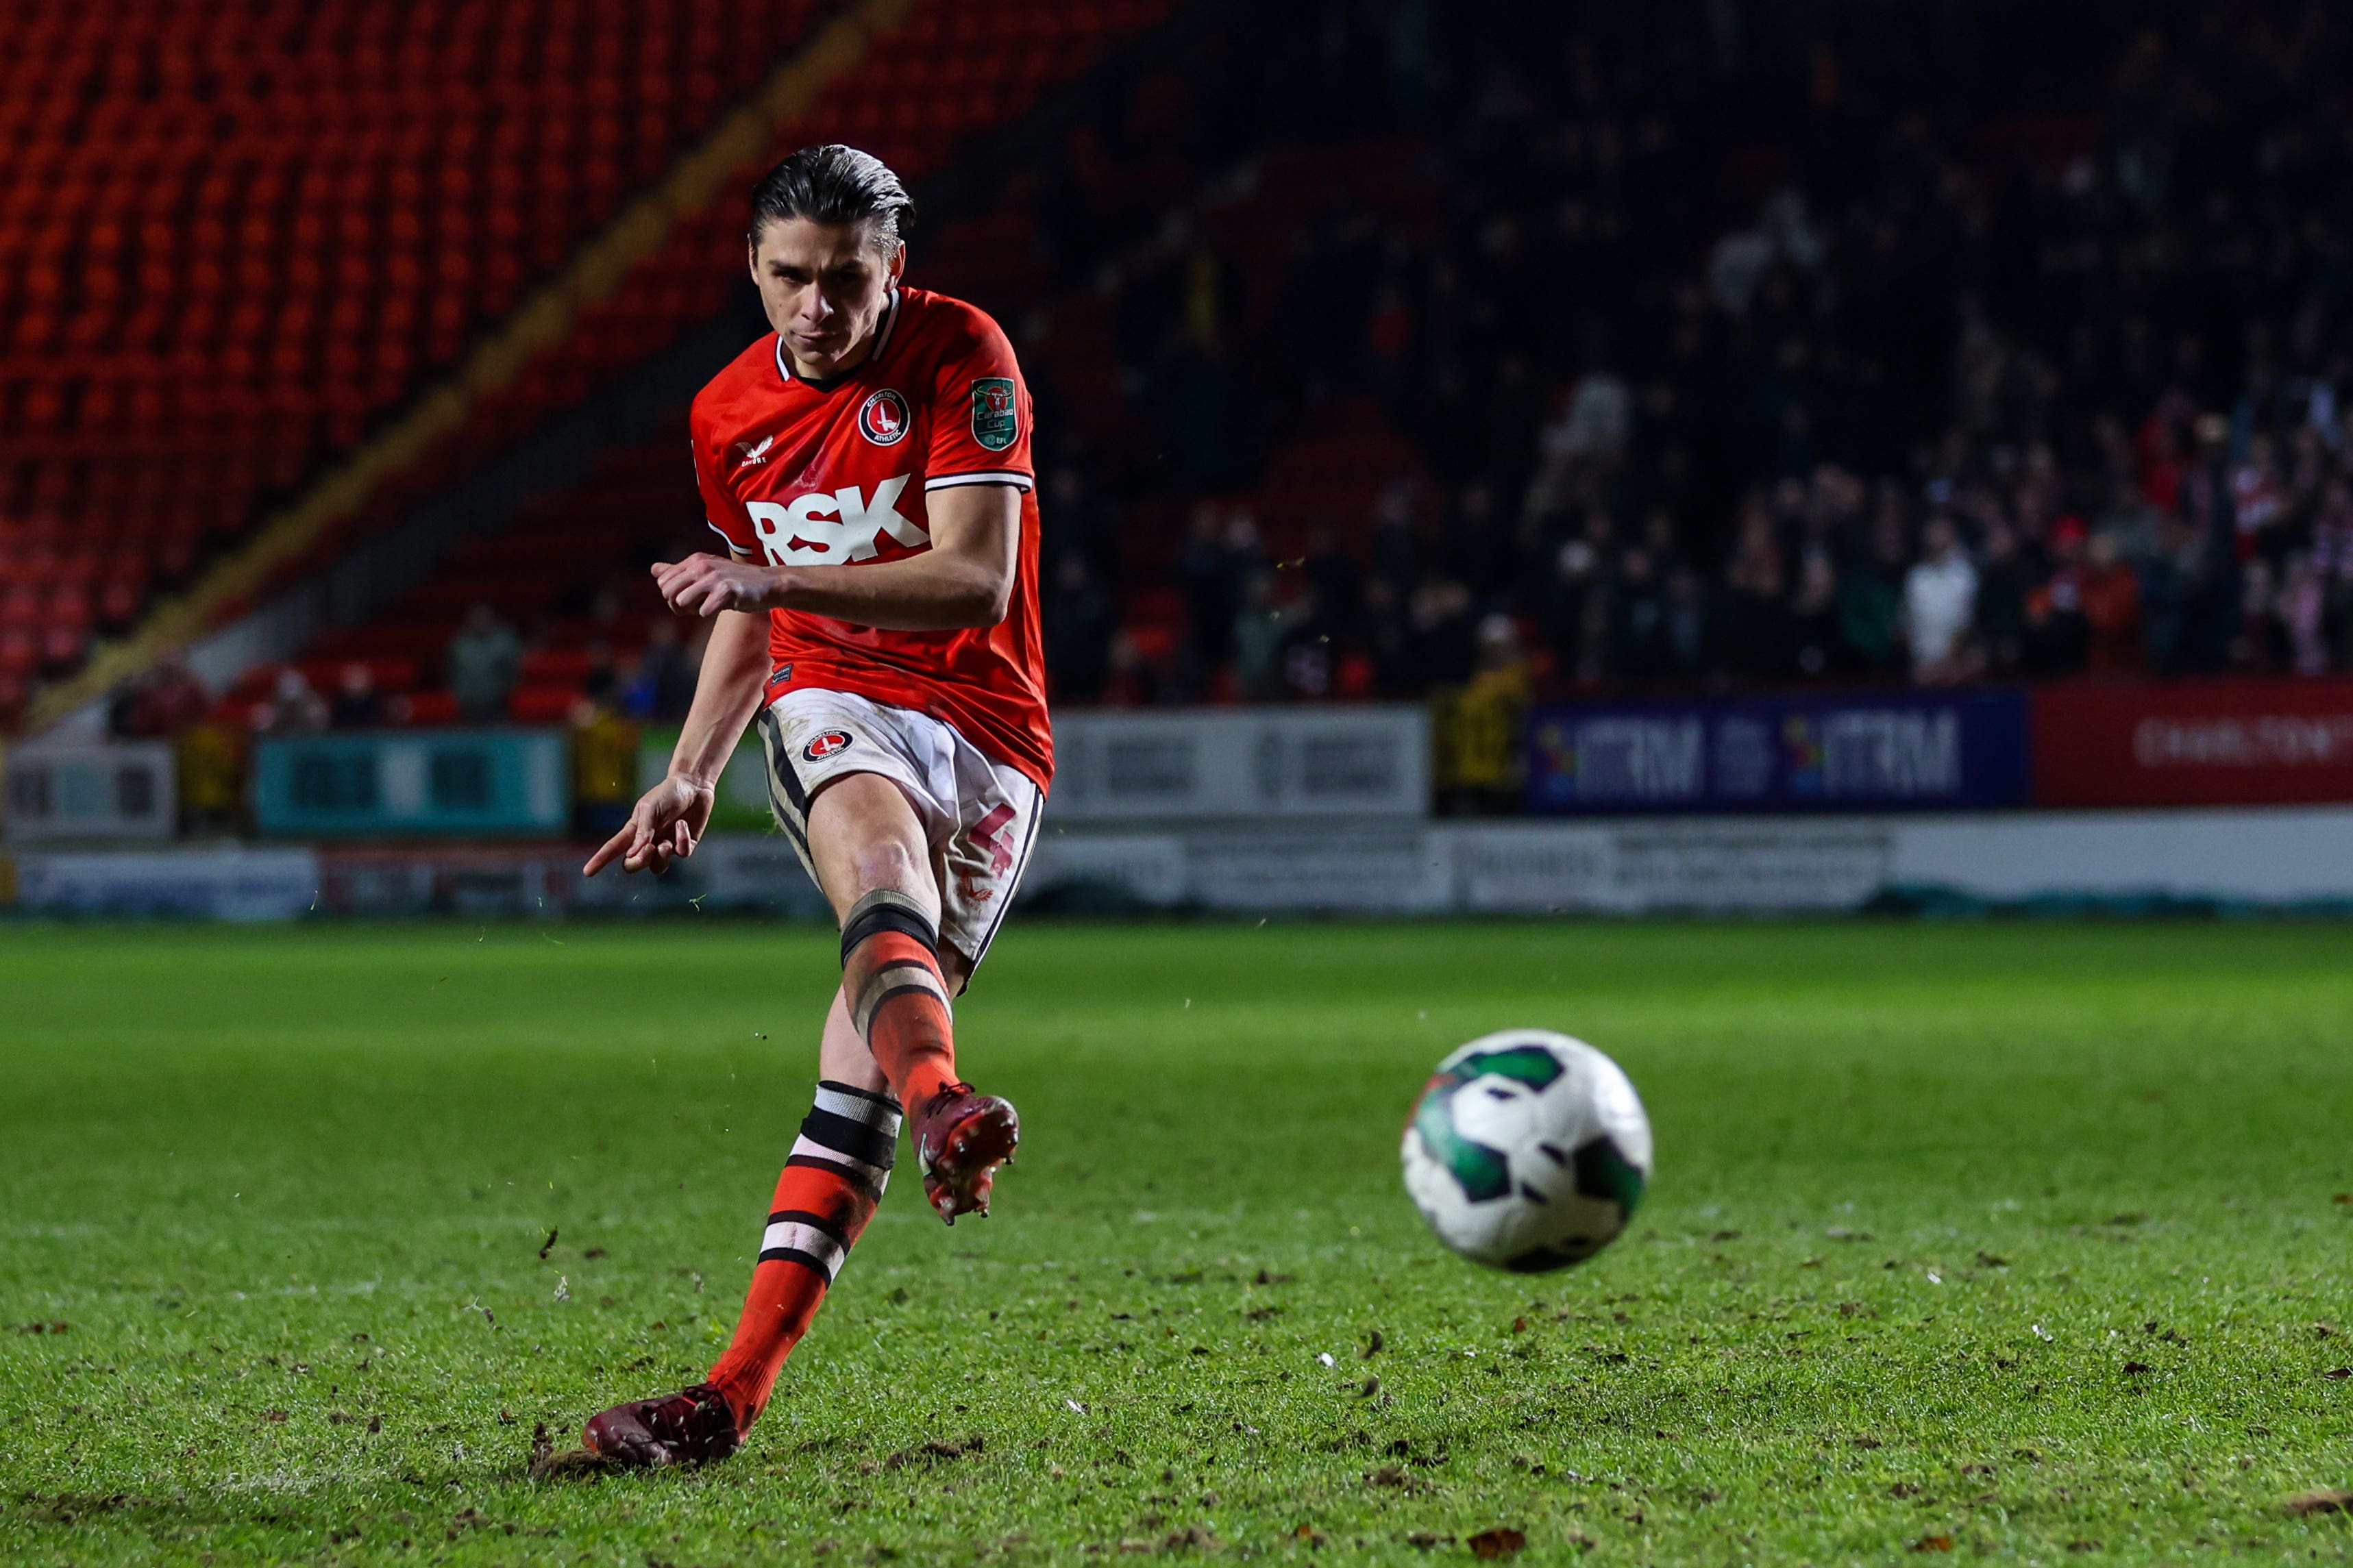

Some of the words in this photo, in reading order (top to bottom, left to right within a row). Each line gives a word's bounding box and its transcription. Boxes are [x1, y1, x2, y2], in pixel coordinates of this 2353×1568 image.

[867, 391, 896, 407] CHARLTON
[976, 408, 1013, 420] Carabao
[987, 421, 1005, 429] Cup
[874, 429, 902, 442] ATHLETIC
[996, 436, 1007, 445] EFL
[746, 473, 931, 567] RSK
